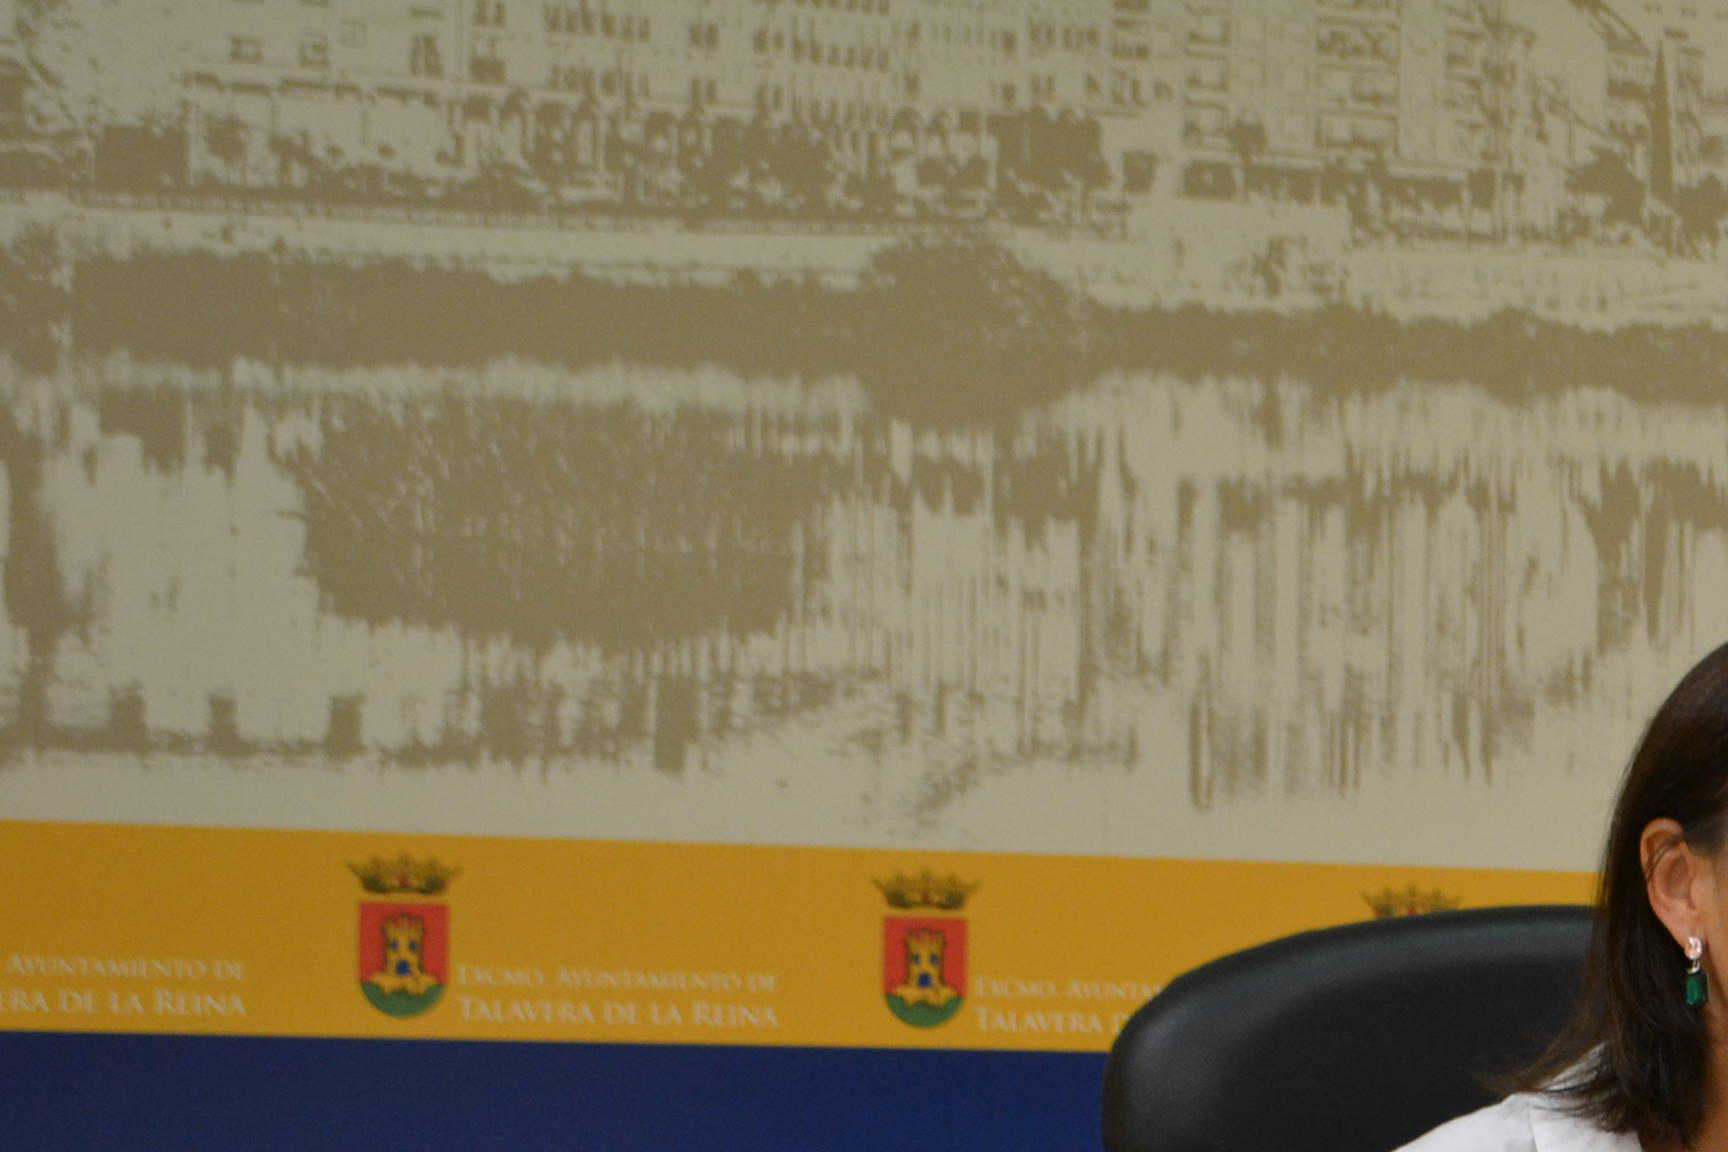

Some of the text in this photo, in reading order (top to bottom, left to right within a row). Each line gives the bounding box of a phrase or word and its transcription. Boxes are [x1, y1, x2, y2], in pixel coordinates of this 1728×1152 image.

[59, 987, 97, 1015] DE
[109, 990, 145, 1016] LA
[154, 985, 247, 1018] REINA
[458, 994, 779, 1029] TALAVERA DE LA REINA
[974, 1006, 1104, 1035] TALAVERA
